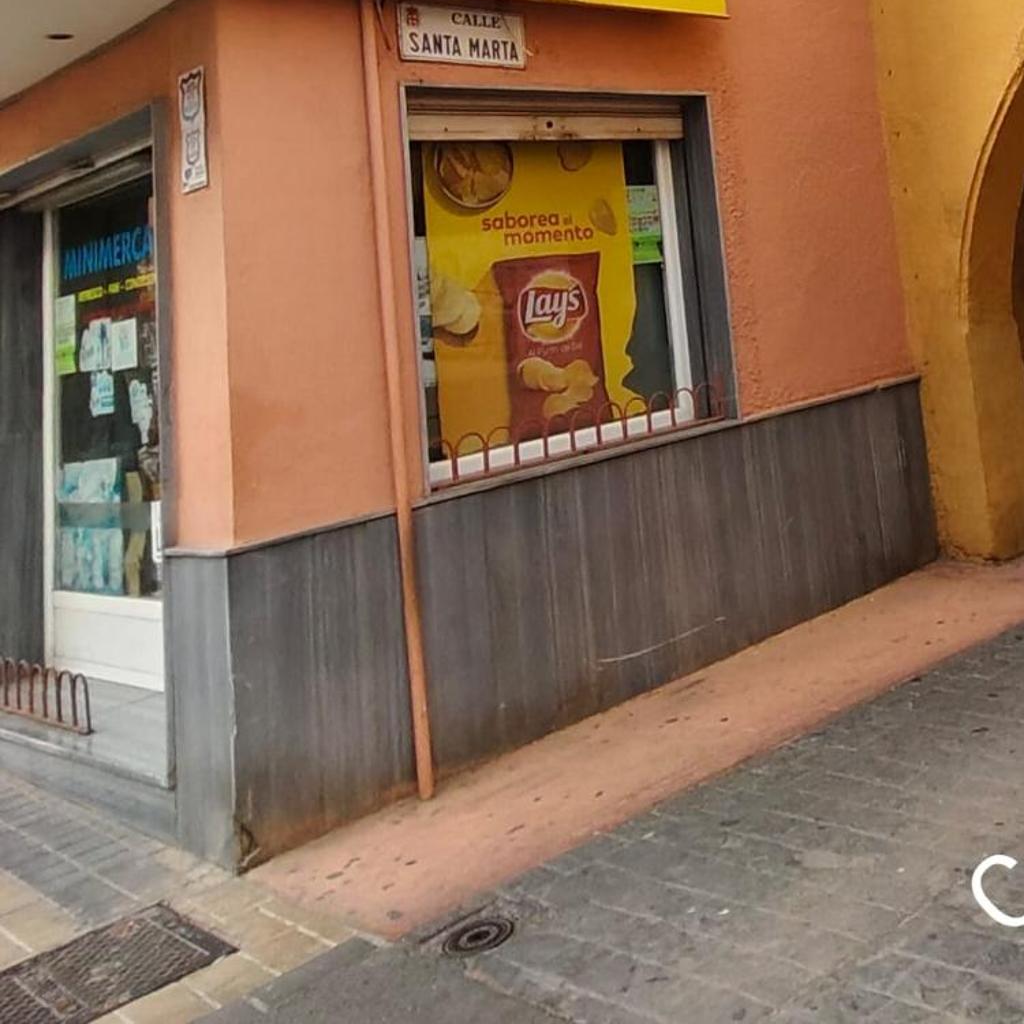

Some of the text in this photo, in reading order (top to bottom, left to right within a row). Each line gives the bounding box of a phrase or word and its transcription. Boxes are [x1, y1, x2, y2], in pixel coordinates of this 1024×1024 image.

[451, 12, 501, 29] CALLE
[409, 32, 519, 61] SANTA MARTA
[481, 211, 559, 231] saborea
[504, 225, 594, 245] momento
[524, 284, 580, 329] Lay's
